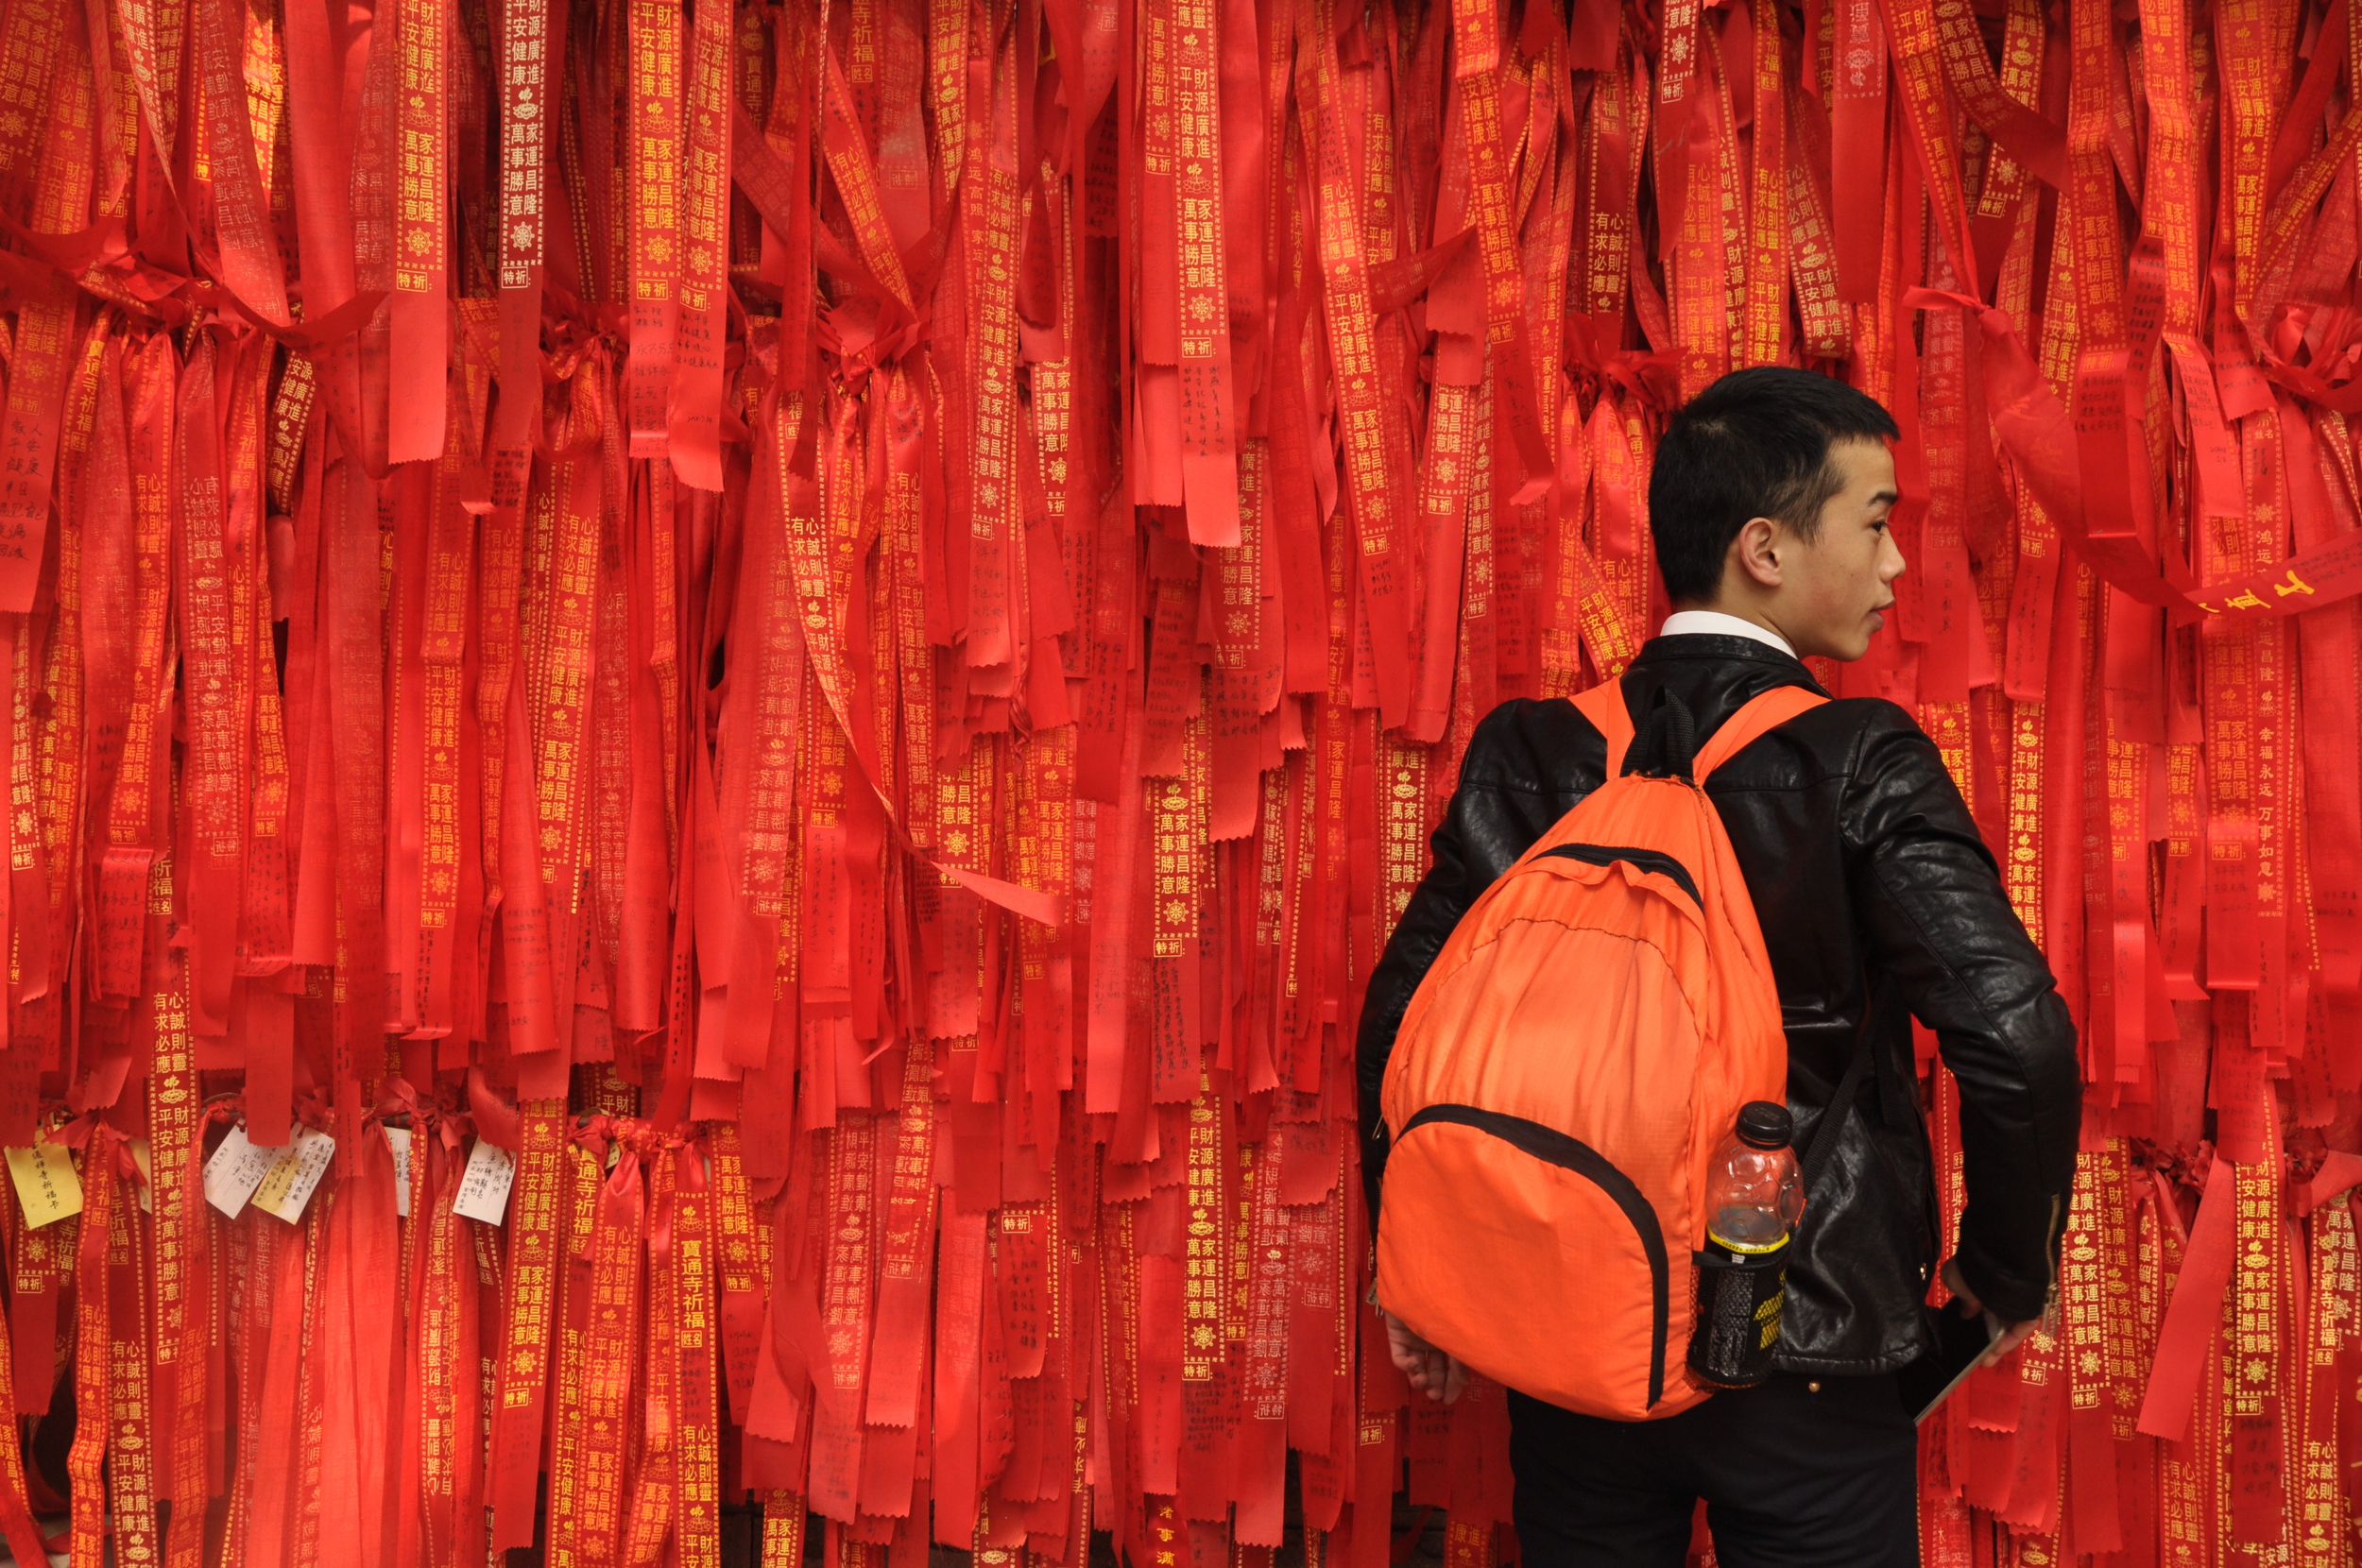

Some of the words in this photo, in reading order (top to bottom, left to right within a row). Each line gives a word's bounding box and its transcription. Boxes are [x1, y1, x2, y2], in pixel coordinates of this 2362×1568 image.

[420, 2, 435, 94] 財源廣進
[641, 2, 655, 96] 平安健康
[657, 6, 673, 98] 財源廣進
[1180, 66, 1194, 158] 平安健康
[1194, 68, 1210, 160] 財源廣進
[404, 129, 419, 222] 萬事勝意
[419, 132, 435, 223] 家運昌隆
[509, 123, 525, 216] 萬事勝意
[524, 122, 538, 215] 家運昌隆
[642, 137, 658, 230] 萬事勝意
[657, 139, 674, 230] 家運昌隆
[1183, 197, 1198, 287] 萬事勝意
[1198, 197, 1216, 288] 家運昌隆
[2082, 215, 2103, 305] 萬事勝意
[2096, 213, 2117, 303] 家運昌隆
[1334, 293, 1358, 376] 平安健康
[1348, 293, 1373, 374] 財源廣進
[1686, 276, 1700, 355] 平安健康
[1701, 277, 1716, 355] 財源廣進
[1754, 281, 1767, 362] 平安健康
[1767, 283, 1780, 363] 財源廣進
[978, 394, 992, 476] 萬事勝意
[989, 398, 1004, 480] 家運昌隆
[1040, 370, 1060, 452] 萬事勝意
[1351, 410, 1373, 492] 萬事勝意
[1364, 408, 1386, 489] 家運昌隆
[560, 513, 580, 593] 有求必應
[575, 516, 594, 596] 心誠則靈
[791, 517, 813, 598] 有求必應
[804, 517, 826, 597] 心誠則靈
[548, 625, 568, 705] 平安健康
[563, 628, 584, 707] 財源廣進
[430, 665, 444, 748] 平安健康
[443, 668, 456, 748] 財源廣進
[539, 740, 557, 821] 萬事勝意
[552, 741, 573, 822] 家運昌隆
[2014, 751, 2026, 832] 平安健康
[2025, 752, 2039, 833] 財源廣進
[2217, 720, 2233, 801] 萬事勝意
[2231, 720, 2249, 802] 家運昌隆
[429, 782, 442, 864] 萬事勝意
[440, 784, 454, 865] 家運昌隆
[1048, 800, 1065, 881] 家運昌隆
[1160, 812, 1174, 895] 萬事勝意
[1174, 813, 1190, 895] 家運昌隆
[1390, 801, 1404, 882] 萬事勝意
[1404, 802, 1417, 882] 家運昌隆
[153, 992, 171, 1075] 有求必應
[168, 991, 187, 1073] 心誠則靈
[157, 1108, 175, 1190] 平安健康
[1200, 1126, 1215, 1207] 財源廣進
[522, 1151, 541, 1232] 平安健康
[536, 1151, 555, 1232] 財源廣進
[720, 1154, 735, 1236] 萬事勝意
[162, 1220, 179, 1303] 萬事勝意
[598, 1225, 616, 1304] 有求必應
[611, 1225, 631, 1305] 心誠則靈
[681, 1239, 706, 1329] 寶通寺祈福
[1187, 1238, 1202, 1319] 萬事勝意
[1202, 1237, 1218, 1320] 家運昌隆
[513, 1266, 530, 1345] 萬事勝意
[526, 1265, 546, 1345] 家運昌隆
[2069, 1264, 2086, 1345] 萬事勝意
[2084, 1263, 2101, 1344] 家運昌隆
[2241, 1271, 2256, 1354] 萬事勝意
[2255, 1271, 2271, 1354] 家運昌隆
[111, 1340, 127, 1420] 有求必應
[127, 1340, 143, 1420] 心誠則靈
[589, 1338, 608, 1417] 平安健康
[603, 1339, 624, 1419] 財源廣進
[117, 1454, 135, 1532] 平安健康
[131, 1453, 151, 1532] 財源廣進
[583, 1451, 602, 1532] 萬事勝意
[595, 1453, 615, 1533] 家運昌隆
[683, 1424, 698, 1502] 有求必應
[697, 1424, 711, 1502] 心誠則靈
[2303, 1441, 2320, 1520] 有求必應
[2319, 1442, 2334, 1521] 心誠則靈
